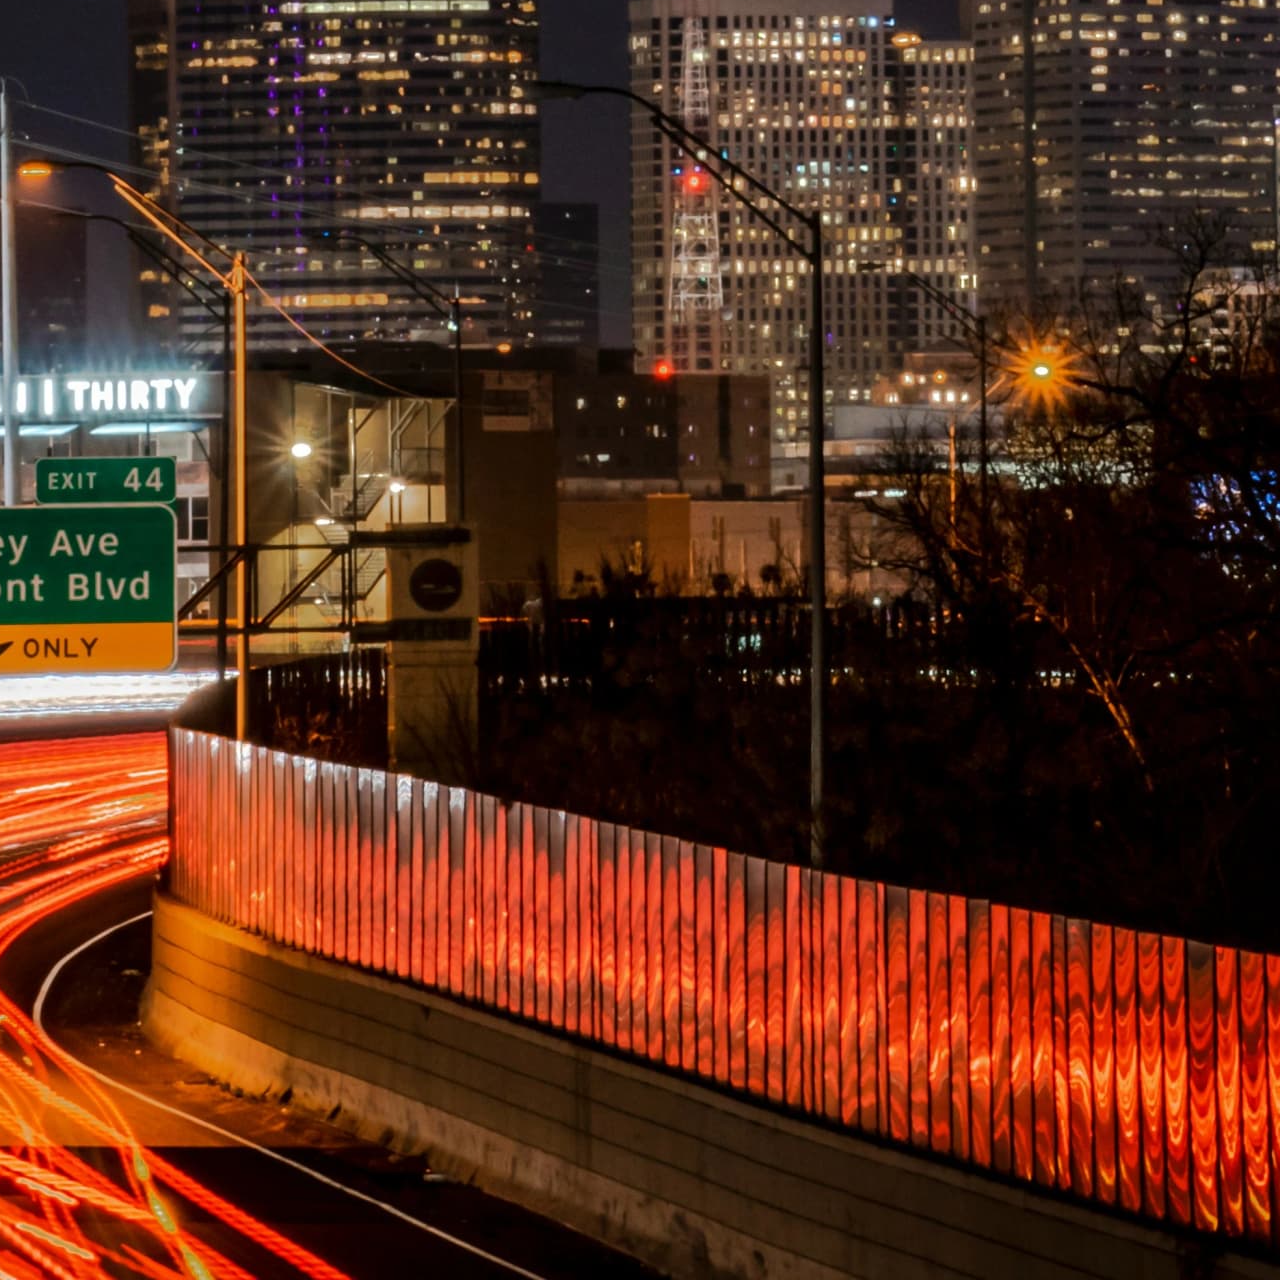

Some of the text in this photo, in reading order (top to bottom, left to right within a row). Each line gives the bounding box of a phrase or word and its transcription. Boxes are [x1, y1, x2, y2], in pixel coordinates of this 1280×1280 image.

[67, 377, 197, 412] THIRTY
[48, 467, 164, 492] EXIT 44
[49, 529, 120, 557] Ave
[67, 571, 150, 601] Blvd
[23, 637, 99, 659] ONLY
